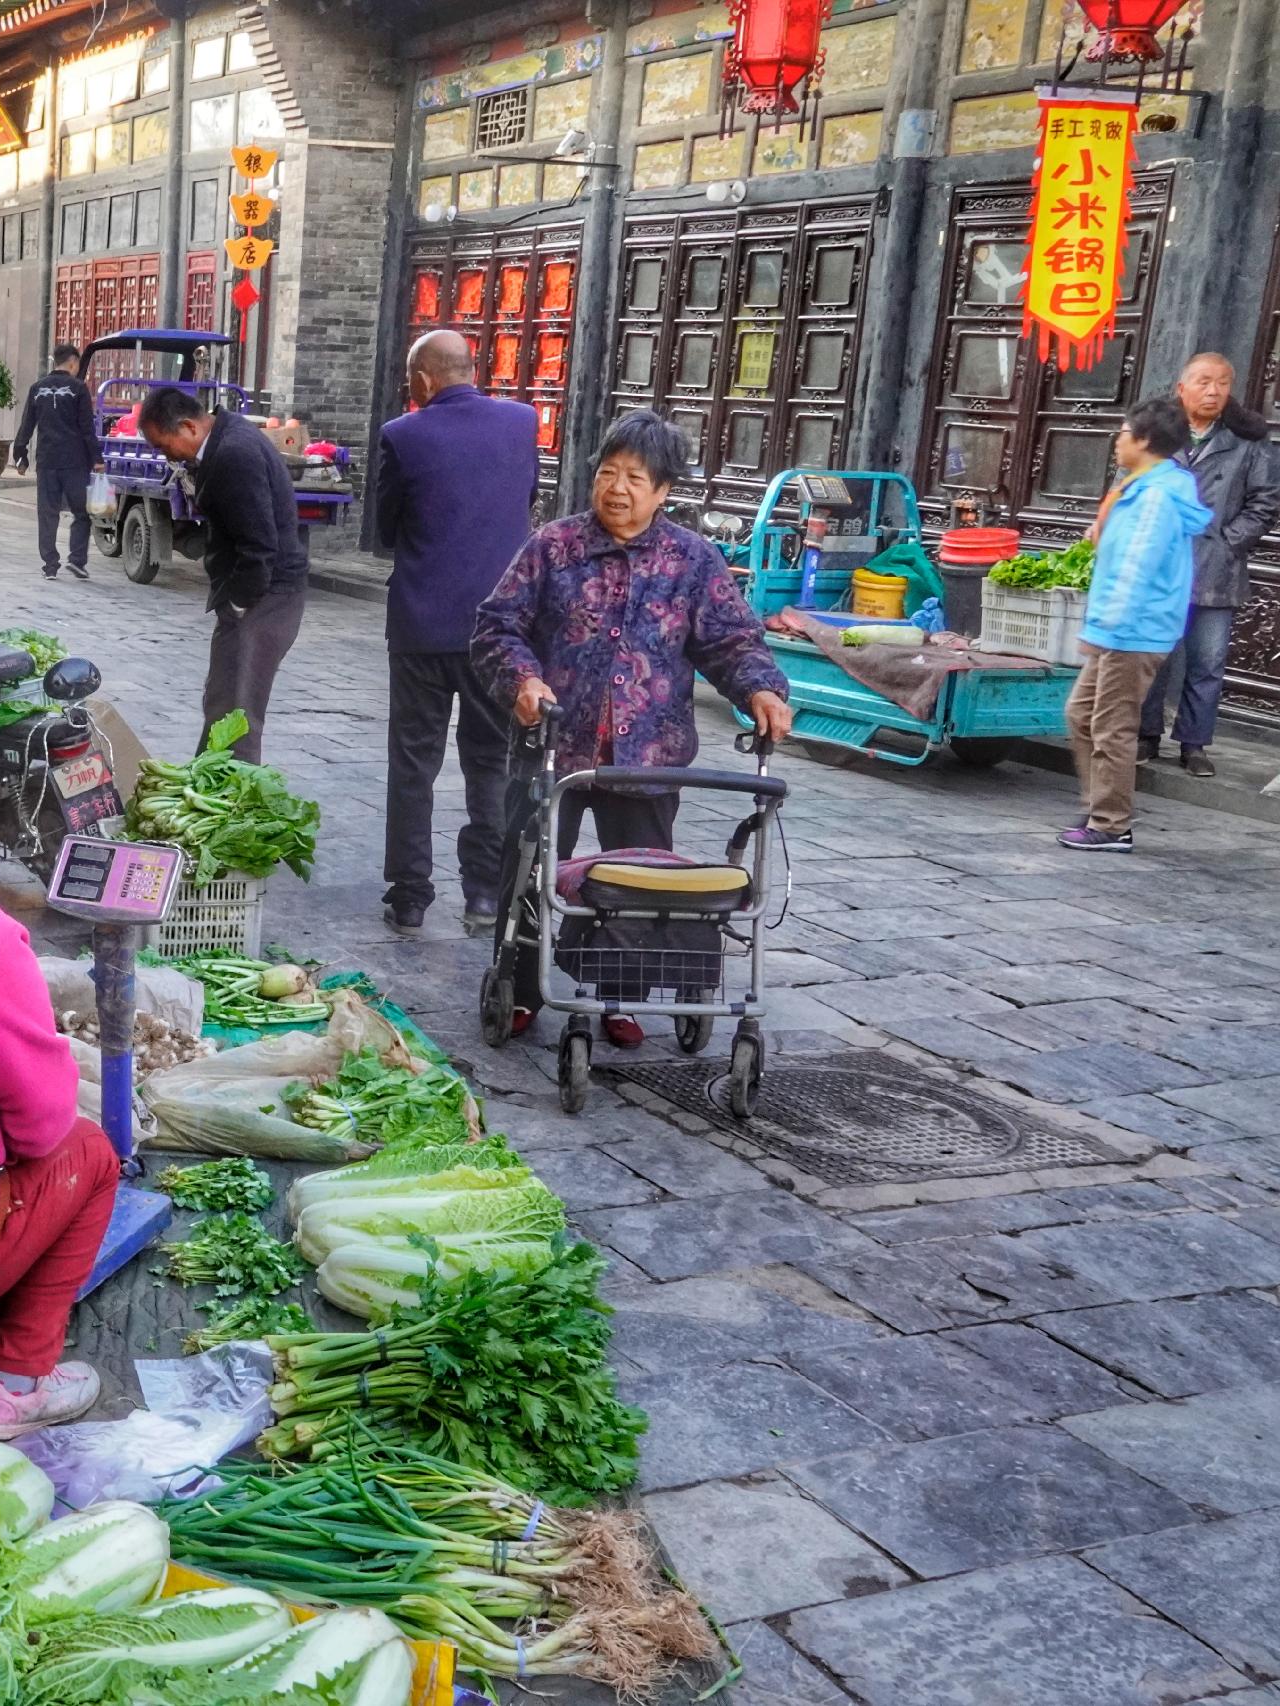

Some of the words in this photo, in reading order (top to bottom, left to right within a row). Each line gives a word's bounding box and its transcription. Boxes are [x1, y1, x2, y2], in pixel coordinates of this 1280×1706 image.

[1049, 117, 1123, 141] 手工现做
[1043, 148, 1111, 317] 小米锅巴
